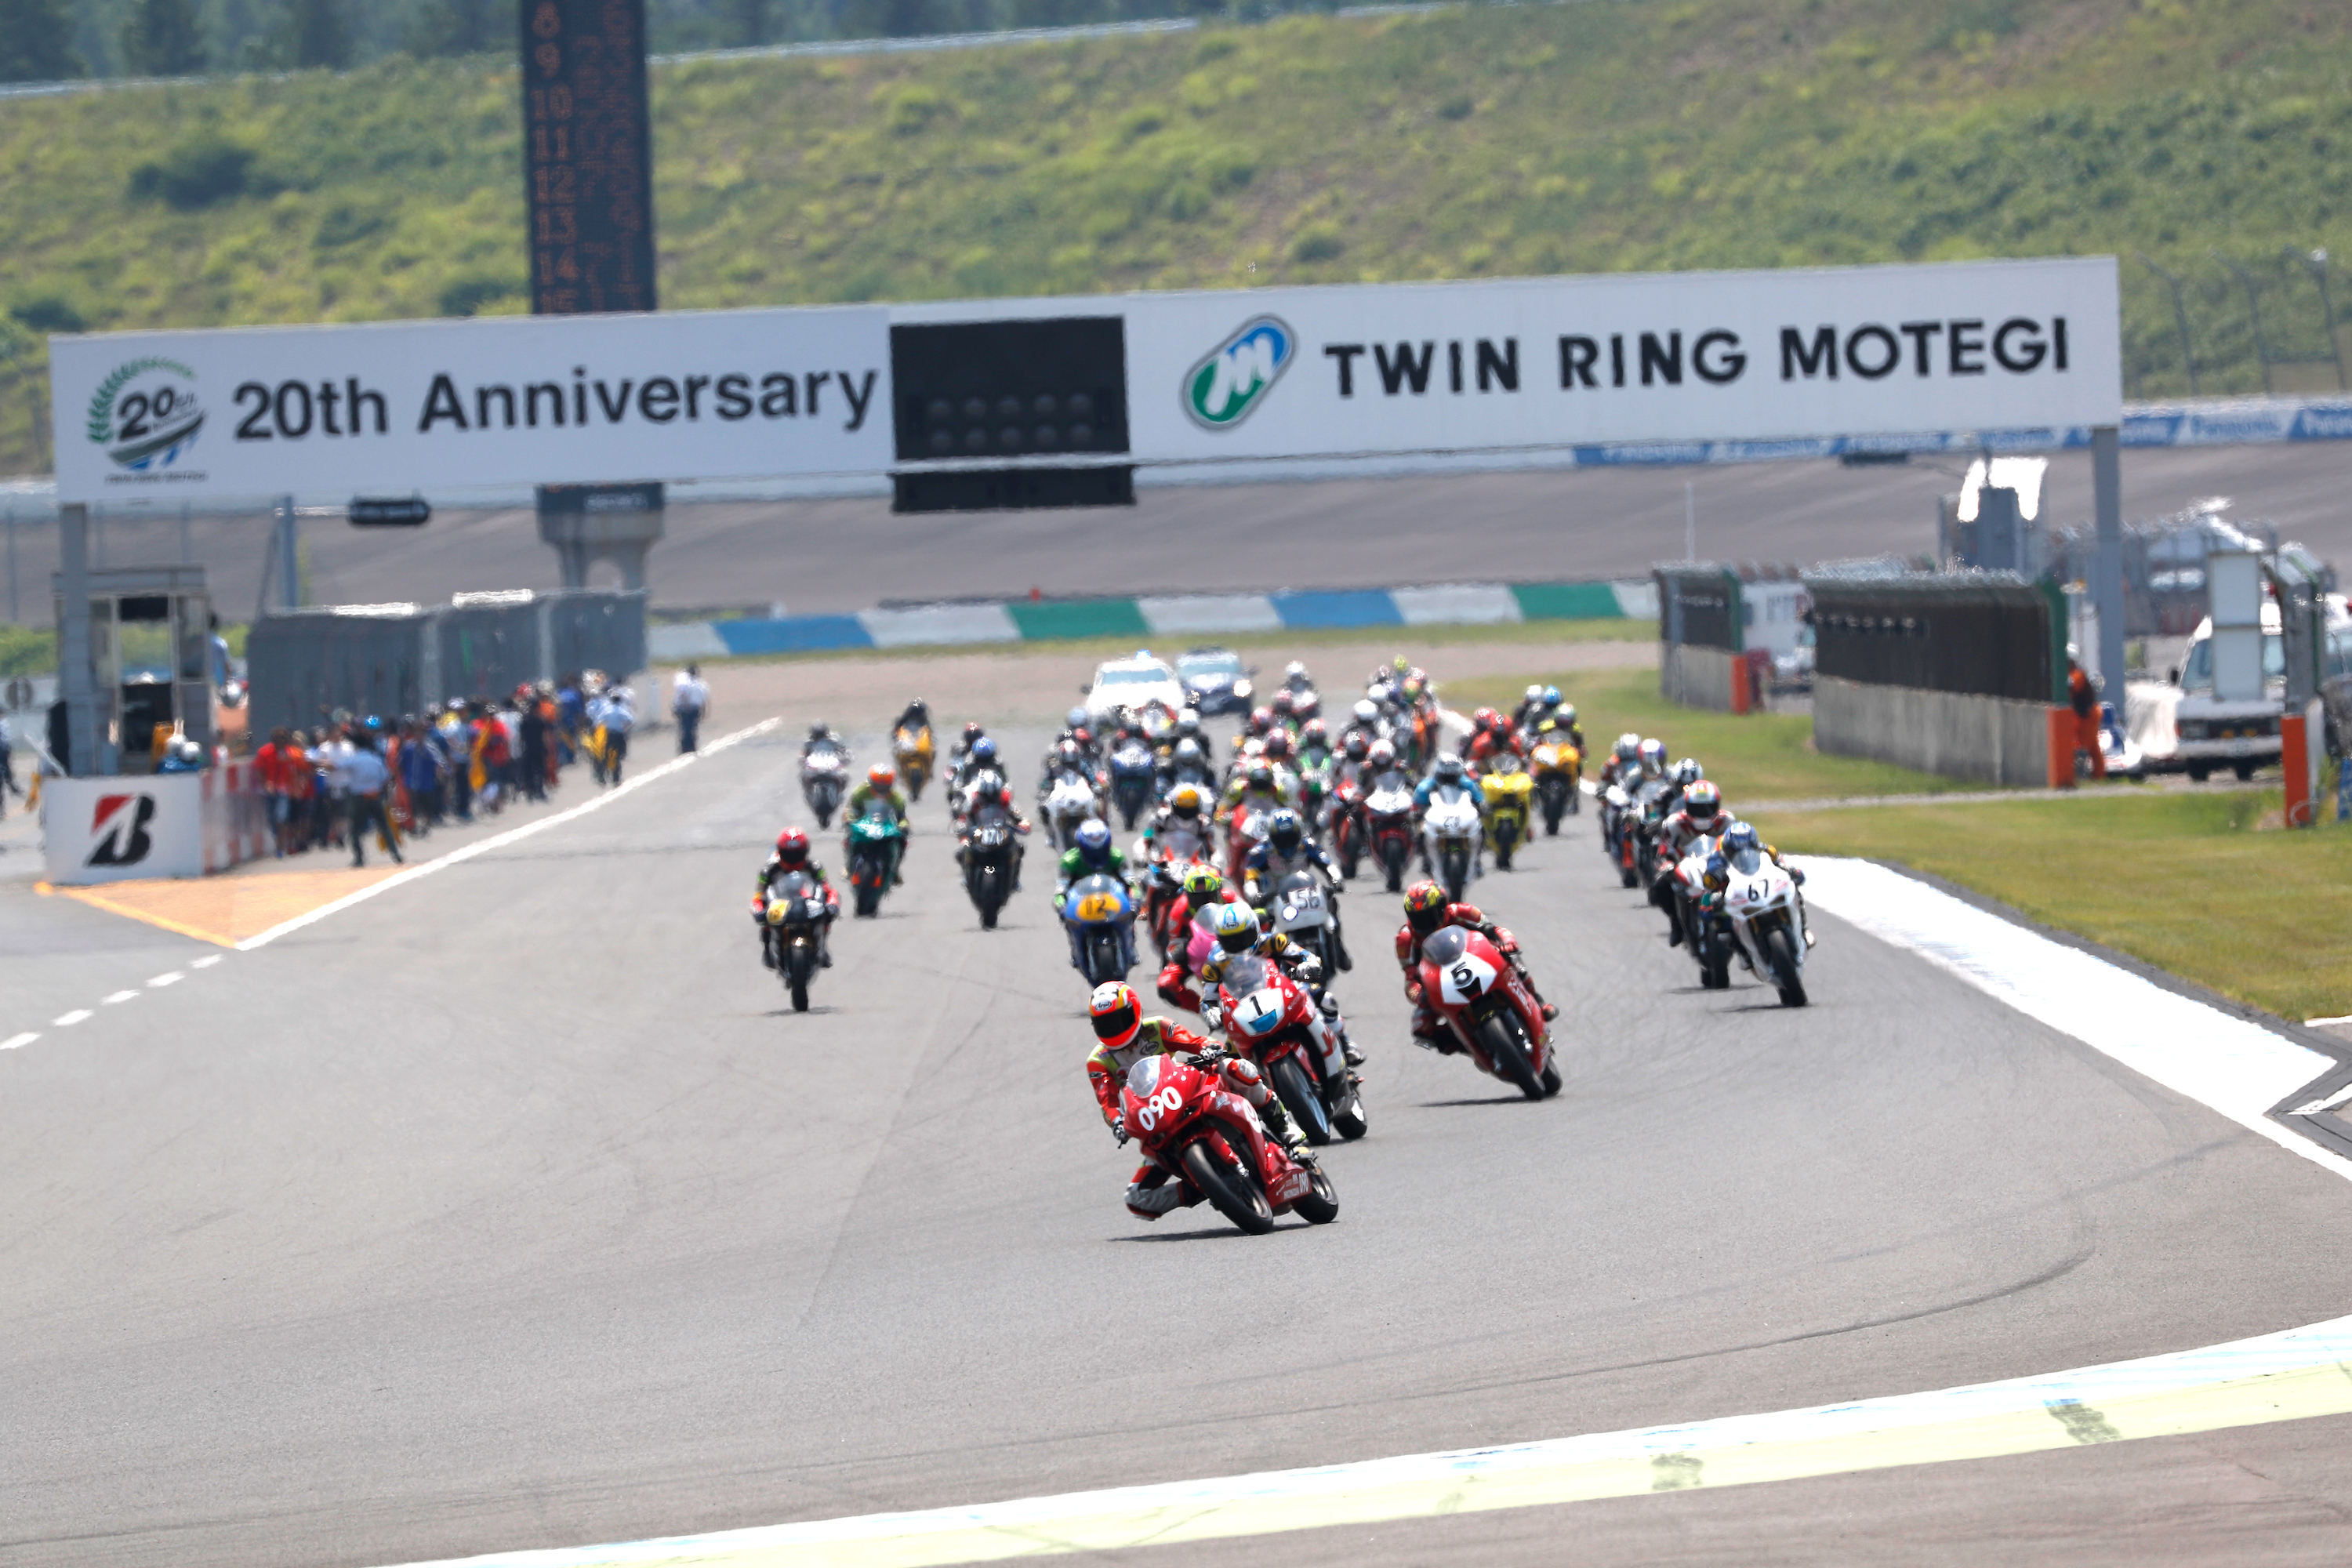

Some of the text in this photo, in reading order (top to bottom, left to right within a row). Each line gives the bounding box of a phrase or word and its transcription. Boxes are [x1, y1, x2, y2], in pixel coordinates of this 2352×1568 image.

[532, 2, 561, 38] 8
[532, 84, 573, 122] 10
[535, 125, 569, 162] 11
[535, 164, 577, 205] 12
[536, 206, 578, 246] 13
[538, 247, 579, 285] 14
[1326, 318, 2067, 396] TWIN RING MOTEGI
[234, 368, 875, 439] 20th Anniversary
[1748, 878, 1769, 902] 67
[1450, 961, 1474, 988] 5
[1250, 995, 1263, 1016] 1
[1138, 1086, 1182, 1131] 090
